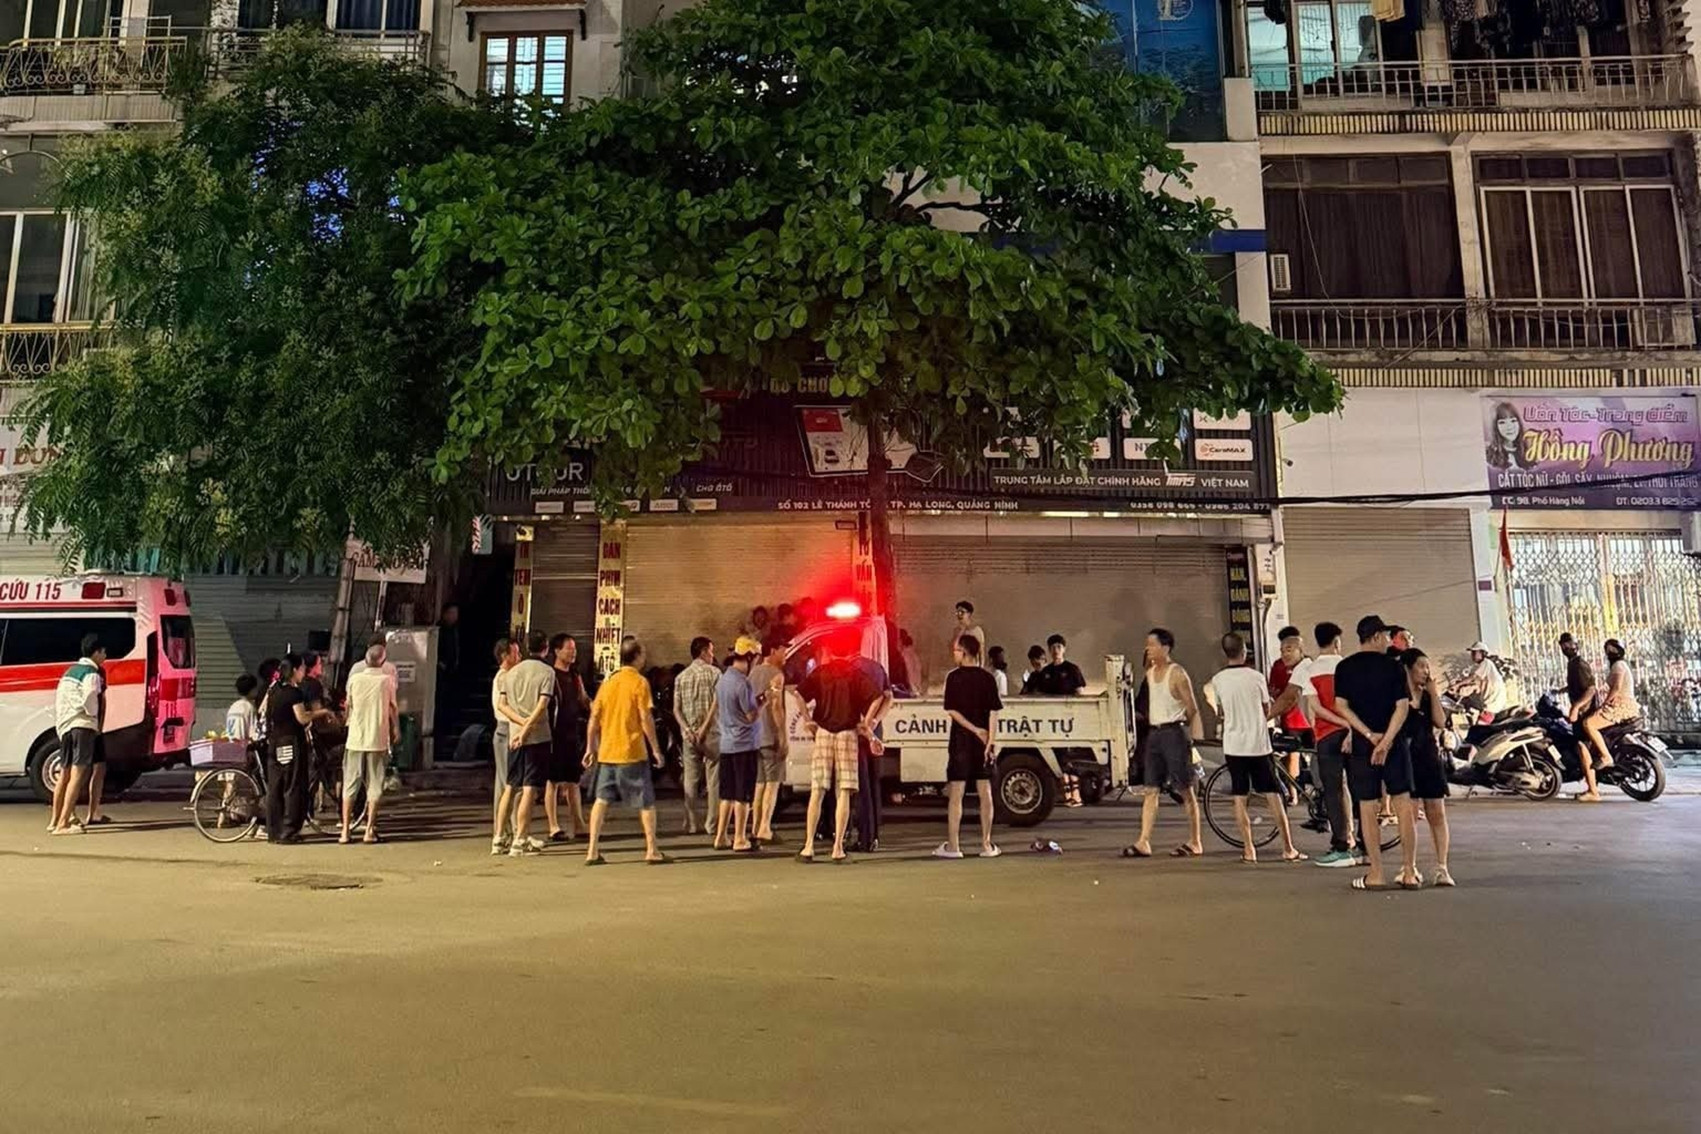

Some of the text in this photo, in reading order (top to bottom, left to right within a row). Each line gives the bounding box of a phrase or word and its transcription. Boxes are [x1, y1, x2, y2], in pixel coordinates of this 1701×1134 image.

[1523, 428, 1695, 470] Hồng Phương
[994, 476, 1028, 485] TRUNG
[1030, 474, 1051, 485] TÂM
[1097, 475, 1130, 486] CHÍNH
[1201, 477, 1223, 489] VIỆT
[1225, 479, 1249, 488] NAM
[812, 499, 822, 509] LÊ
[956, 498, 991, 510] QUẢNG
[600, 570, 621, 586] PHIM
[0, 578, 62, 600] CỨU 115
[598, 595, 620, 615] CÁCH
[595, 623, 621, 646] NHIỆT
[895, 714, 1075, 738] CẢNH TRẬT TỰ
